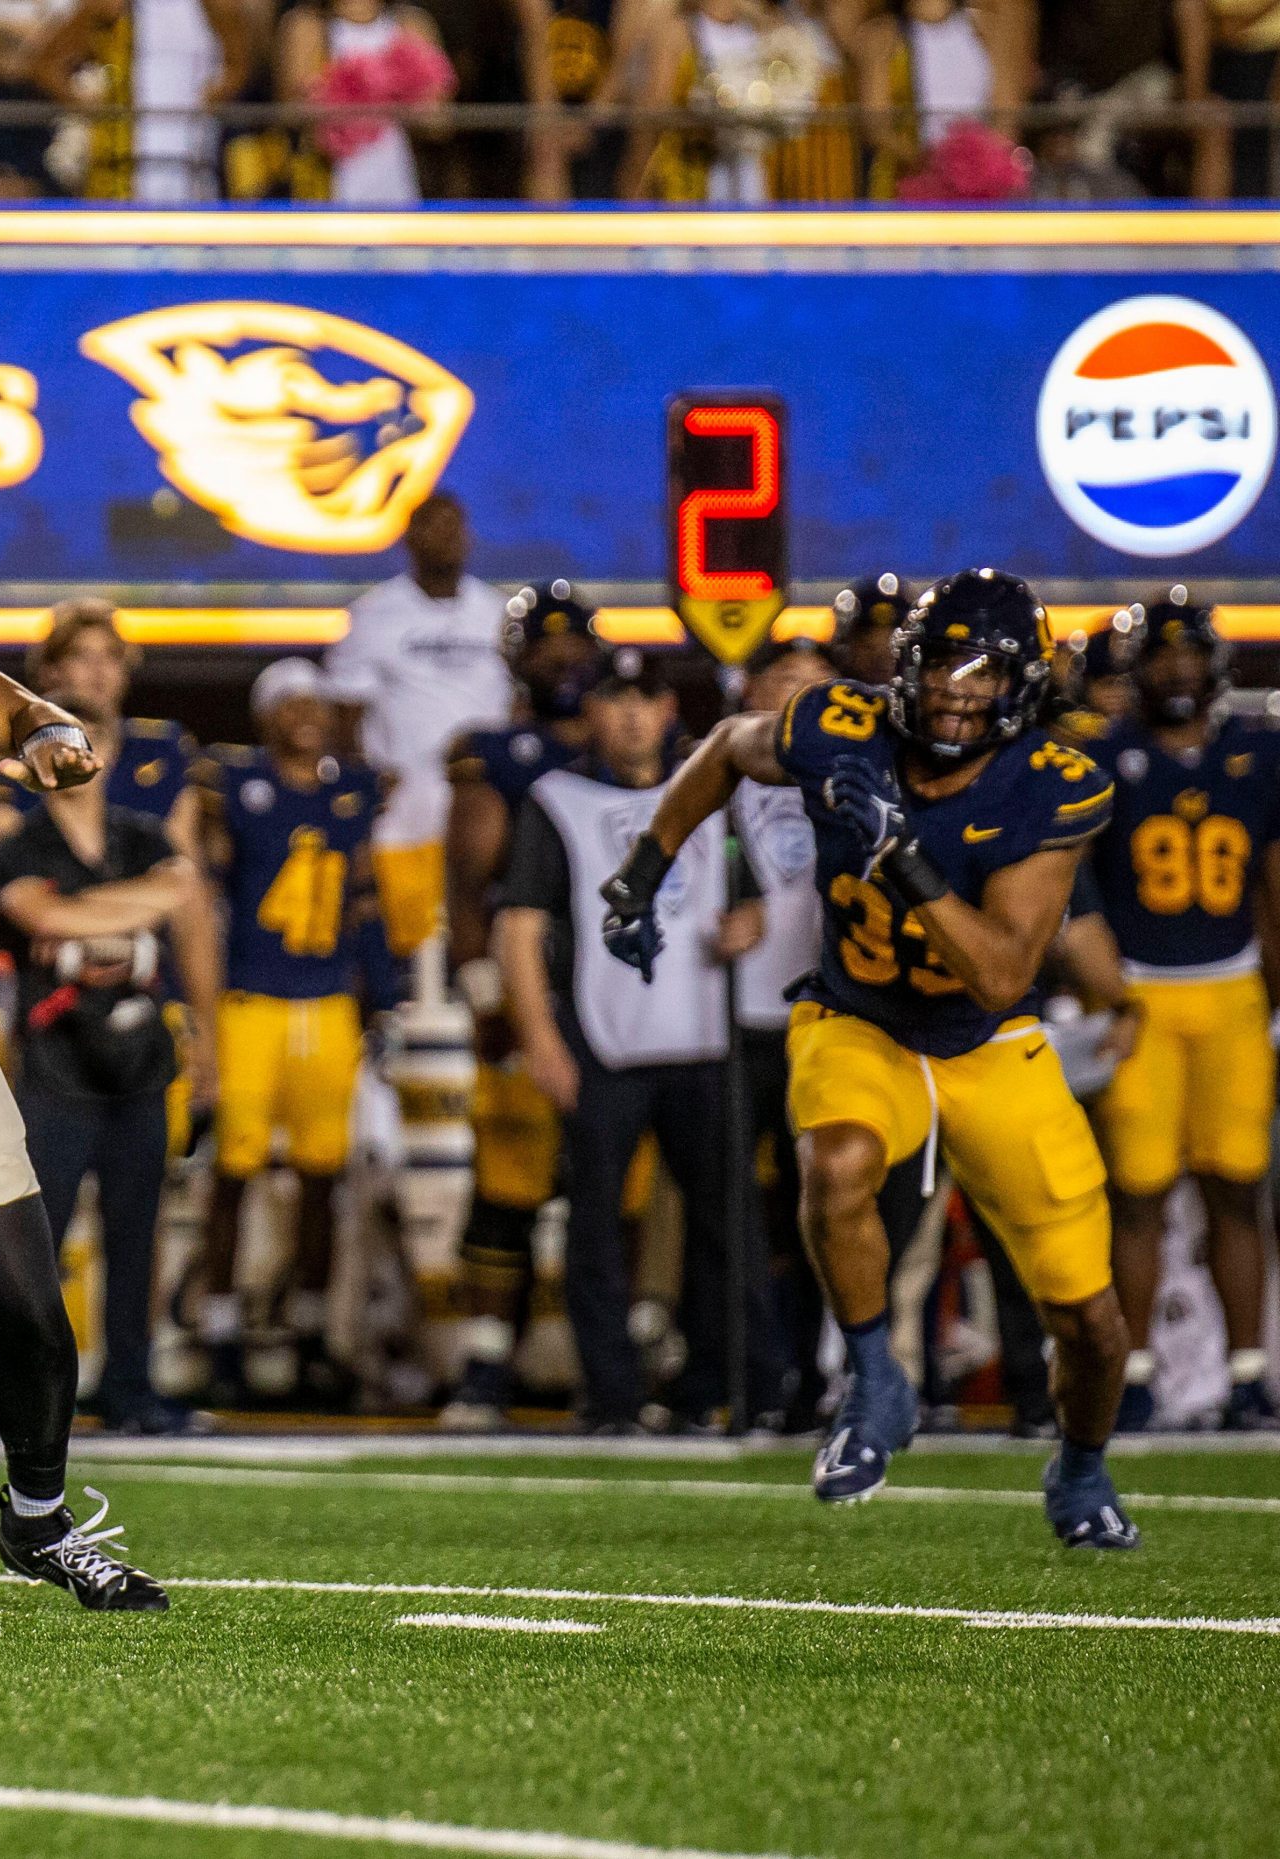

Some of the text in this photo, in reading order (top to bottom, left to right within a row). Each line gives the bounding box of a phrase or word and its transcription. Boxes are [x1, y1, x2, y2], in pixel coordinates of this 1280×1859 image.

[1065, 406, 1250, 440] PEPSI
[678, 406, 780, 600] 2
[257, 846, 349, 958] 41
